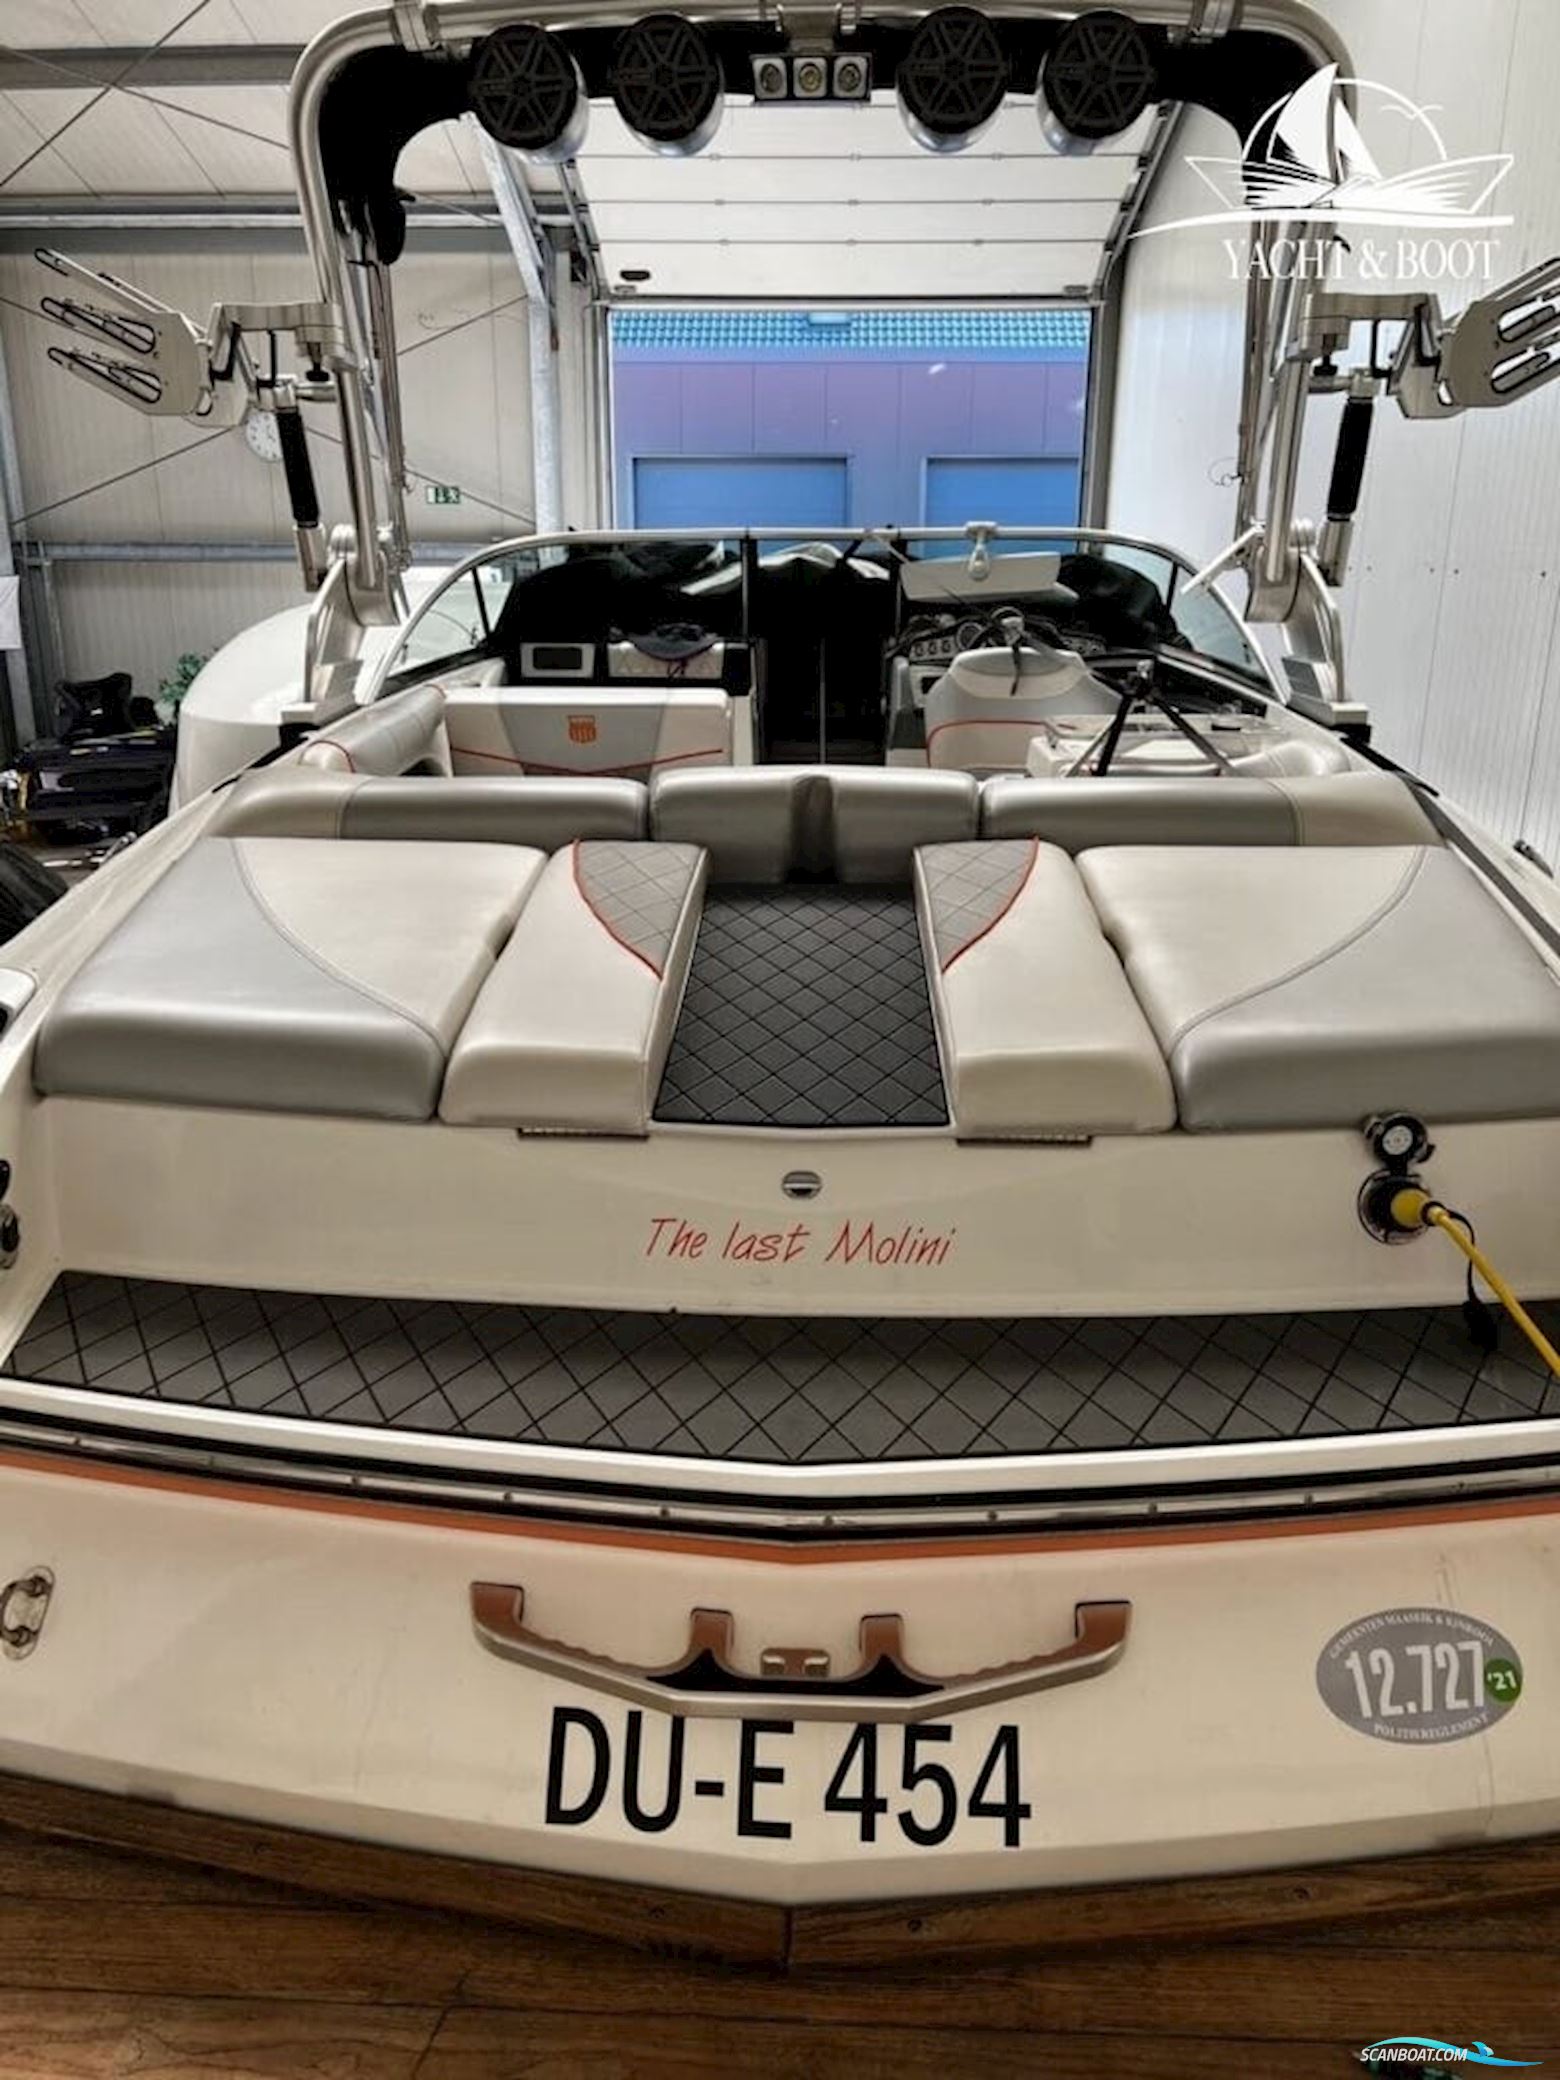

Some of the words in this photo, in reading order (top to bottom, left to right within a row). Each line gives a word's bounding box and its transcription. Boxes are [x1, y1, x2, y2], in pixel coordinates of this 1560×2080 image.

[646, 1217, 708, 1259] The
[722, 1221, 811, 1263] last
[825, 1218, 957, 1267] Molini
[1345, 1640, 1485, 1718] 12.727
[545, 1706, 795, 1840] DU-E
[824, 1722, 1032, 1848] 454
